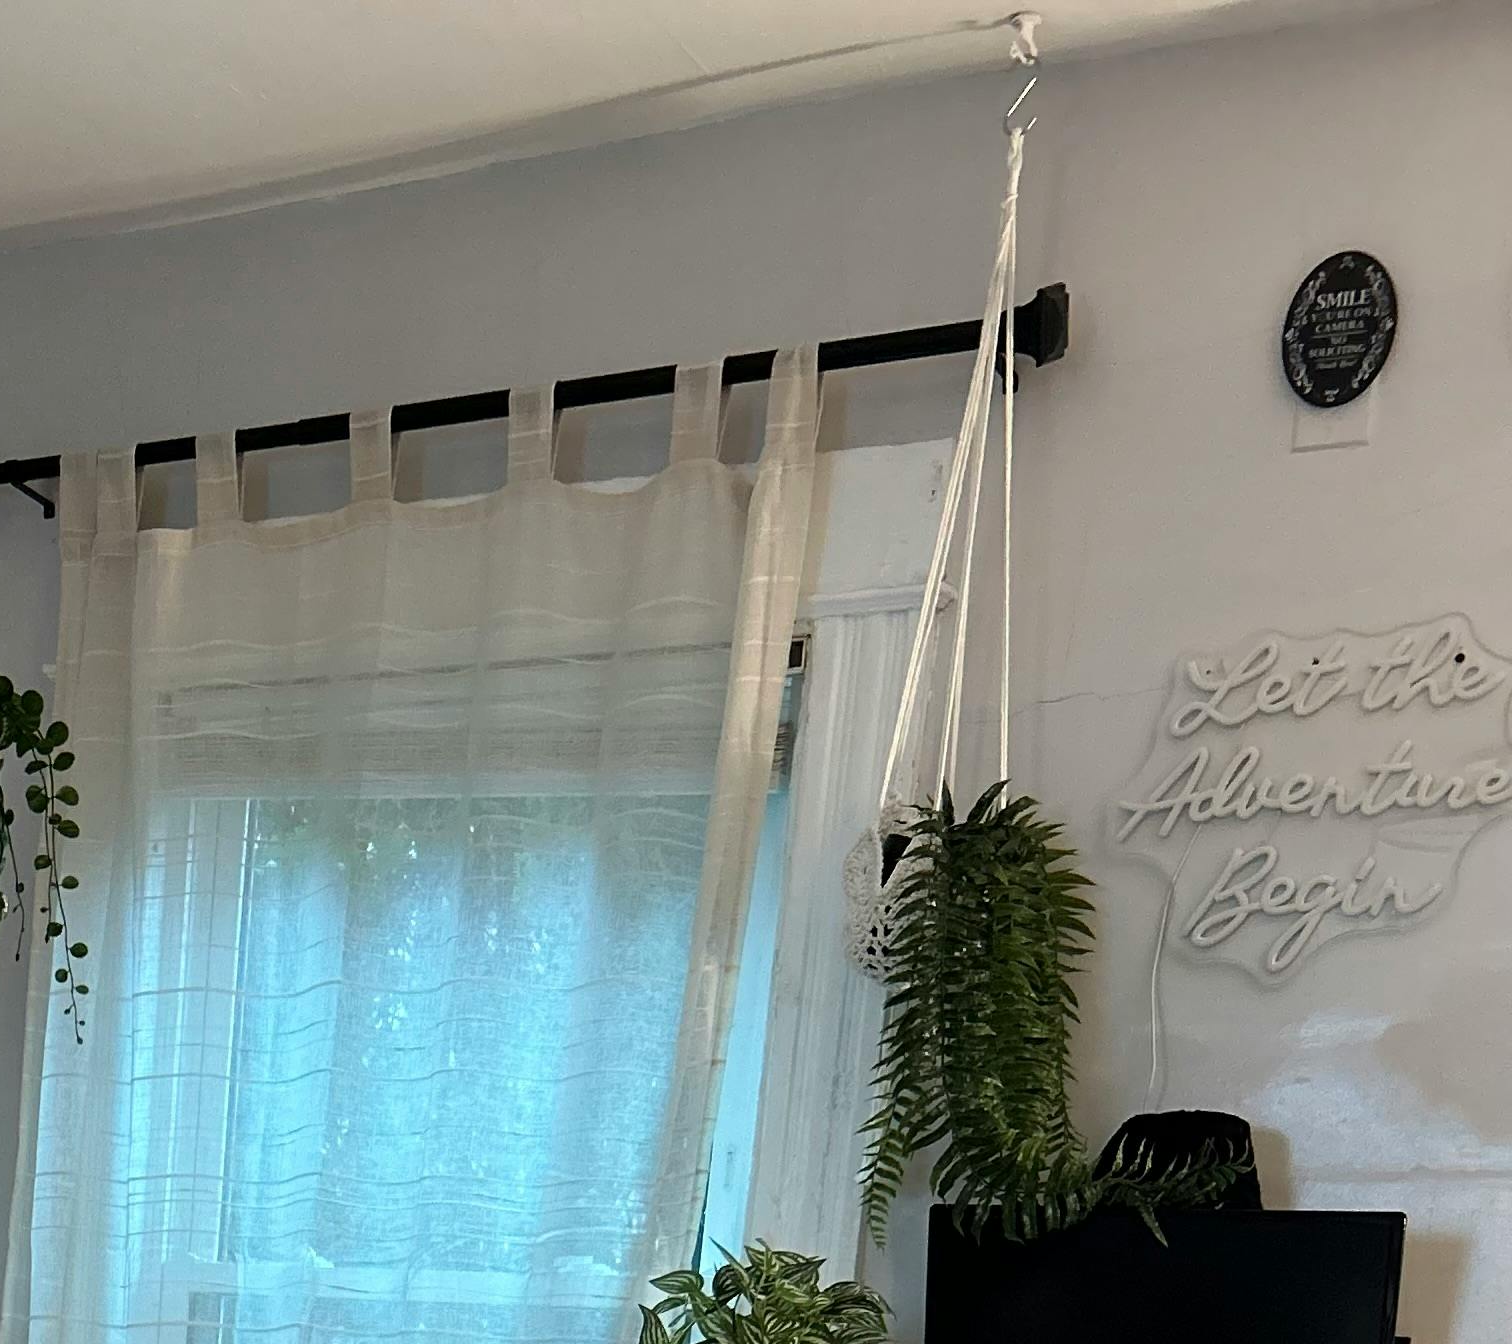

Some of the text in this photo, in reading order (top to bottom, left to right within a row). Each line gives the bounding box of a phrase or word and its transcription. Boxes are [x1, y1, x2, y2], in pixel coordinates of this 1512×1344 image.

[1315, 289, 1370, 310] SMILE
[1170, 630, 1505, 737] Let the
[1116, 739, 1512, 844] Adventure
[1185, 844, 1443, 973] Begin
